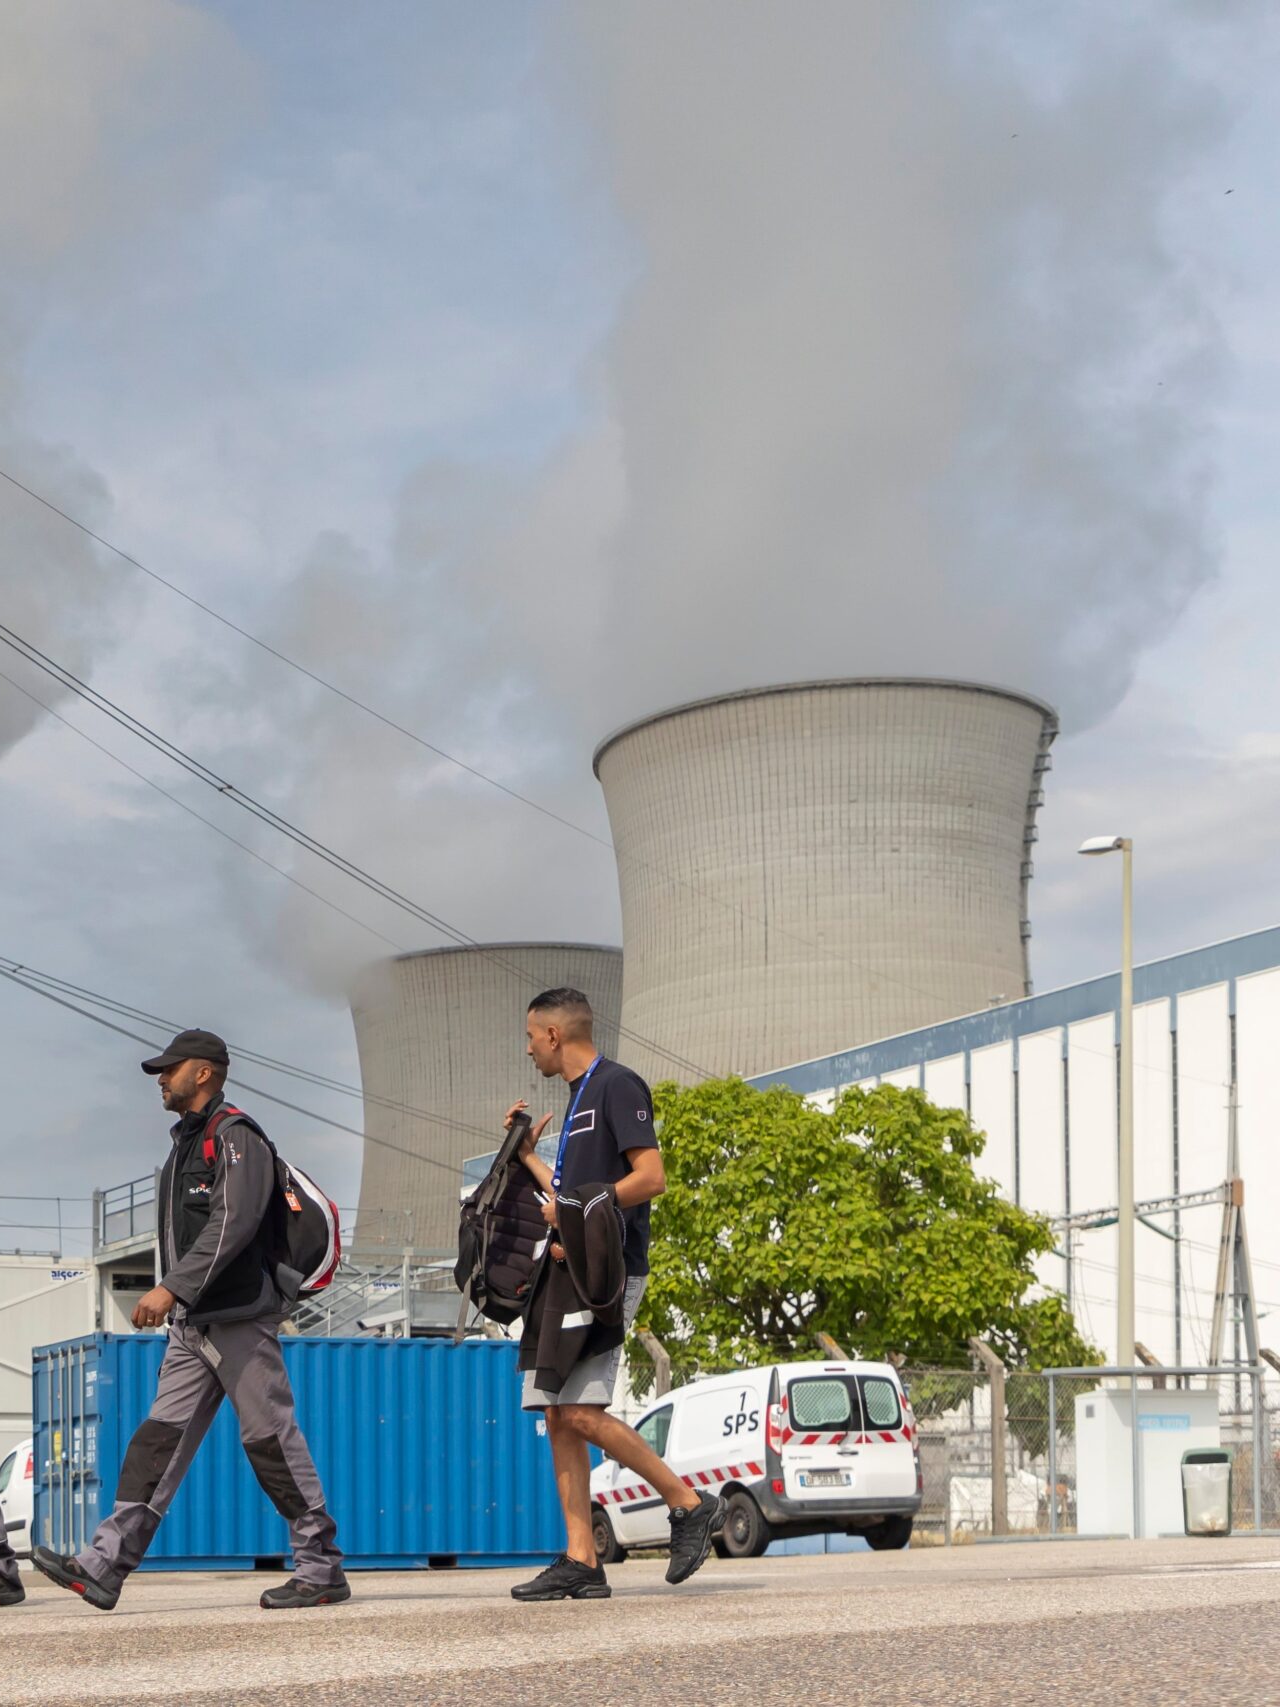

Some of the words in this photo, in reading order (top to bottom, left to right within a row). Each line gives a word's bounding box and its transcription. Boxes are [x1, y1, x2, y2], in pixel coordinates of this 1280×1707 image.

[188, 1185, 212, 1194] SPIE
[739, 1391, 747, 1412] 1
[723, 1410, 760, 1437] SPS
